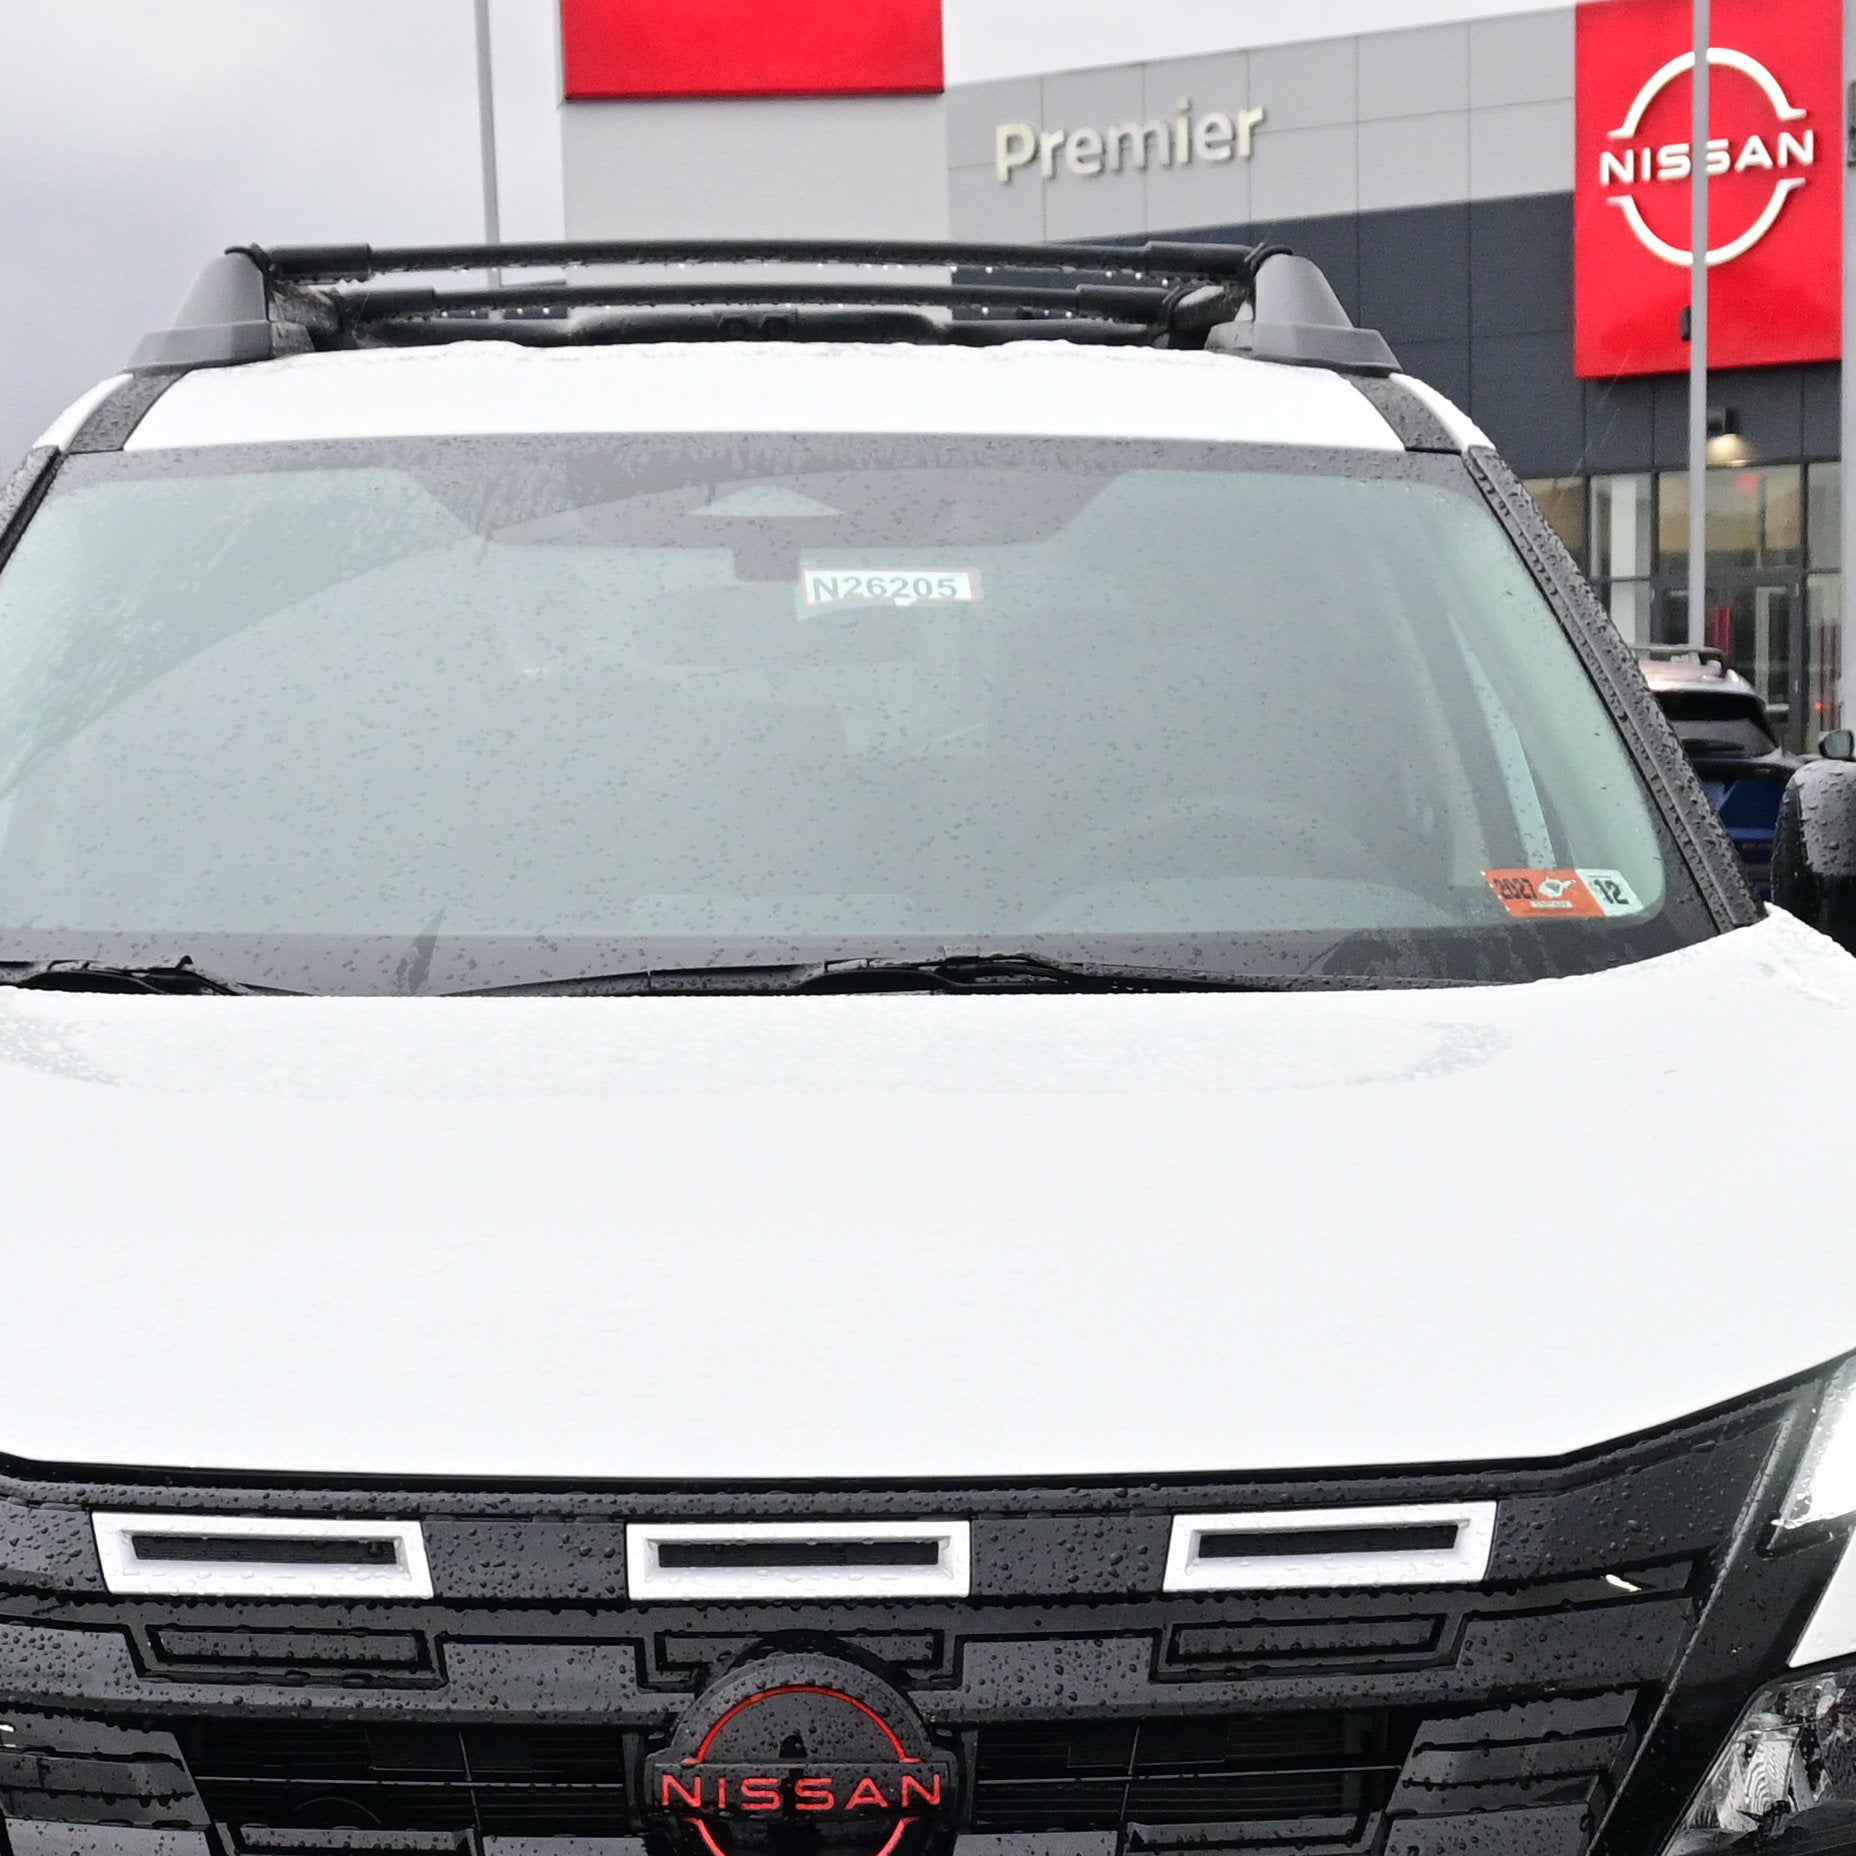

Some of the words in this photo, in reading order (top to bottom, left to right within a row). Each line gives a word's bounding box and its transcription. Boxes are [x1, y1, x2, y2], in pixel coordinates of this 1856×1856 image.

[995, 97, 1264, 183] Premier
[1599, 128, 1815, 187] NISSAN
[812, 576, 959, 601] N26205
[1593, 879, 1630, 905] 12
[661, 1773, 942, 1811] NISSAN
